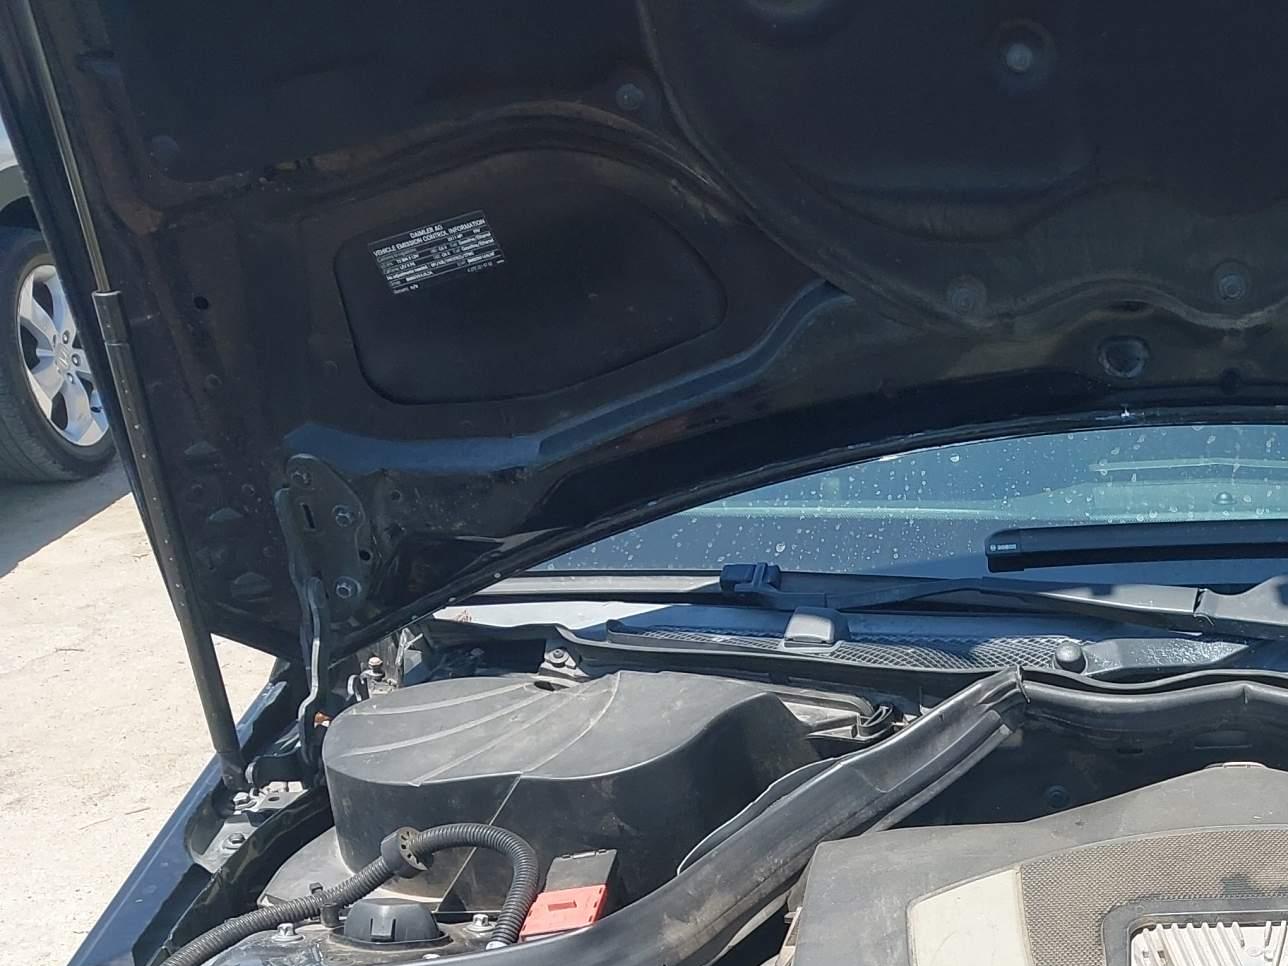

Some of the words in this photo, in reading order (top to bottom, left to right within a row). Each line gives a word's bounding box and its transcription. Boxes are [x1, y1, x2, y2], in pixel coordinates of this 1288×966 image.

[373, 245, 397, 257] VEHICLE
[423, 230, 448, 242] CONTROL
[448, 219, 485, 234] INFORMATION
